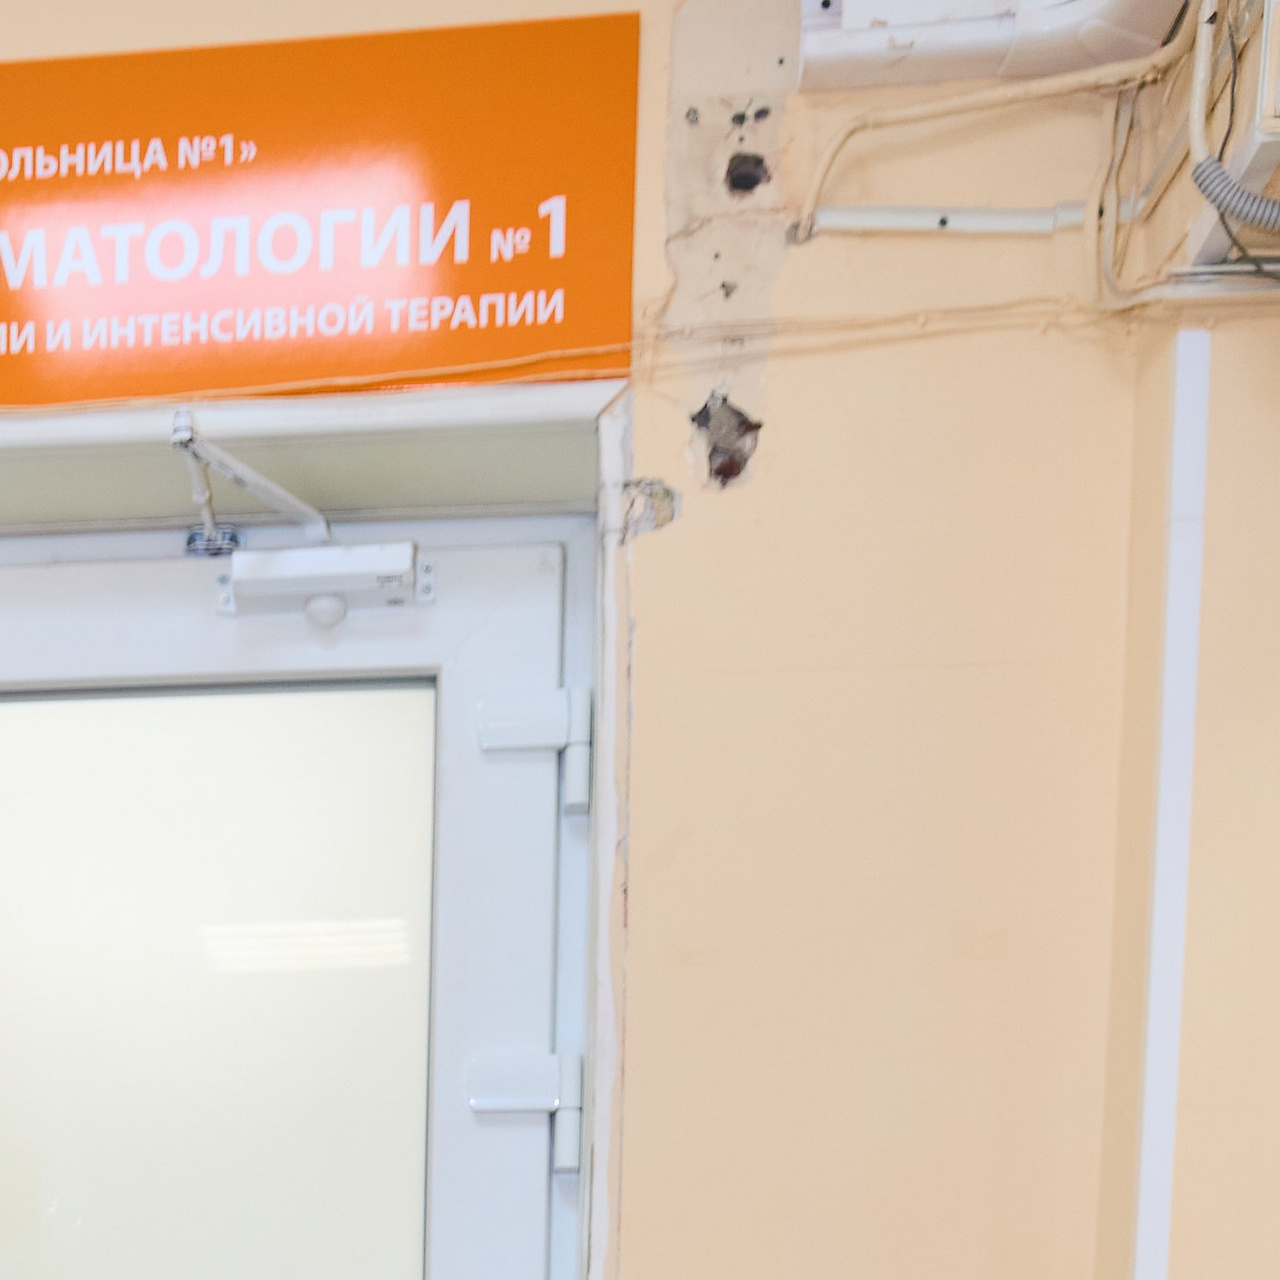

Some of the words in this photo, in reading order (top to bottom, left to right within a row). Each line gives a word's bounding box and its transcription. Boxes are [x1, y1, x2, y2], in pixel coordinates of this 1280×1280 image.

[177, 134, 257, 168] №1»
[537, 195, 567, 258] 1
[45, 318, 72, 351] И
[81, 297, 375, 350] ИНТЕНСИВНОЙ
[384, 289, 565, 332] ТЕРАПИИ
